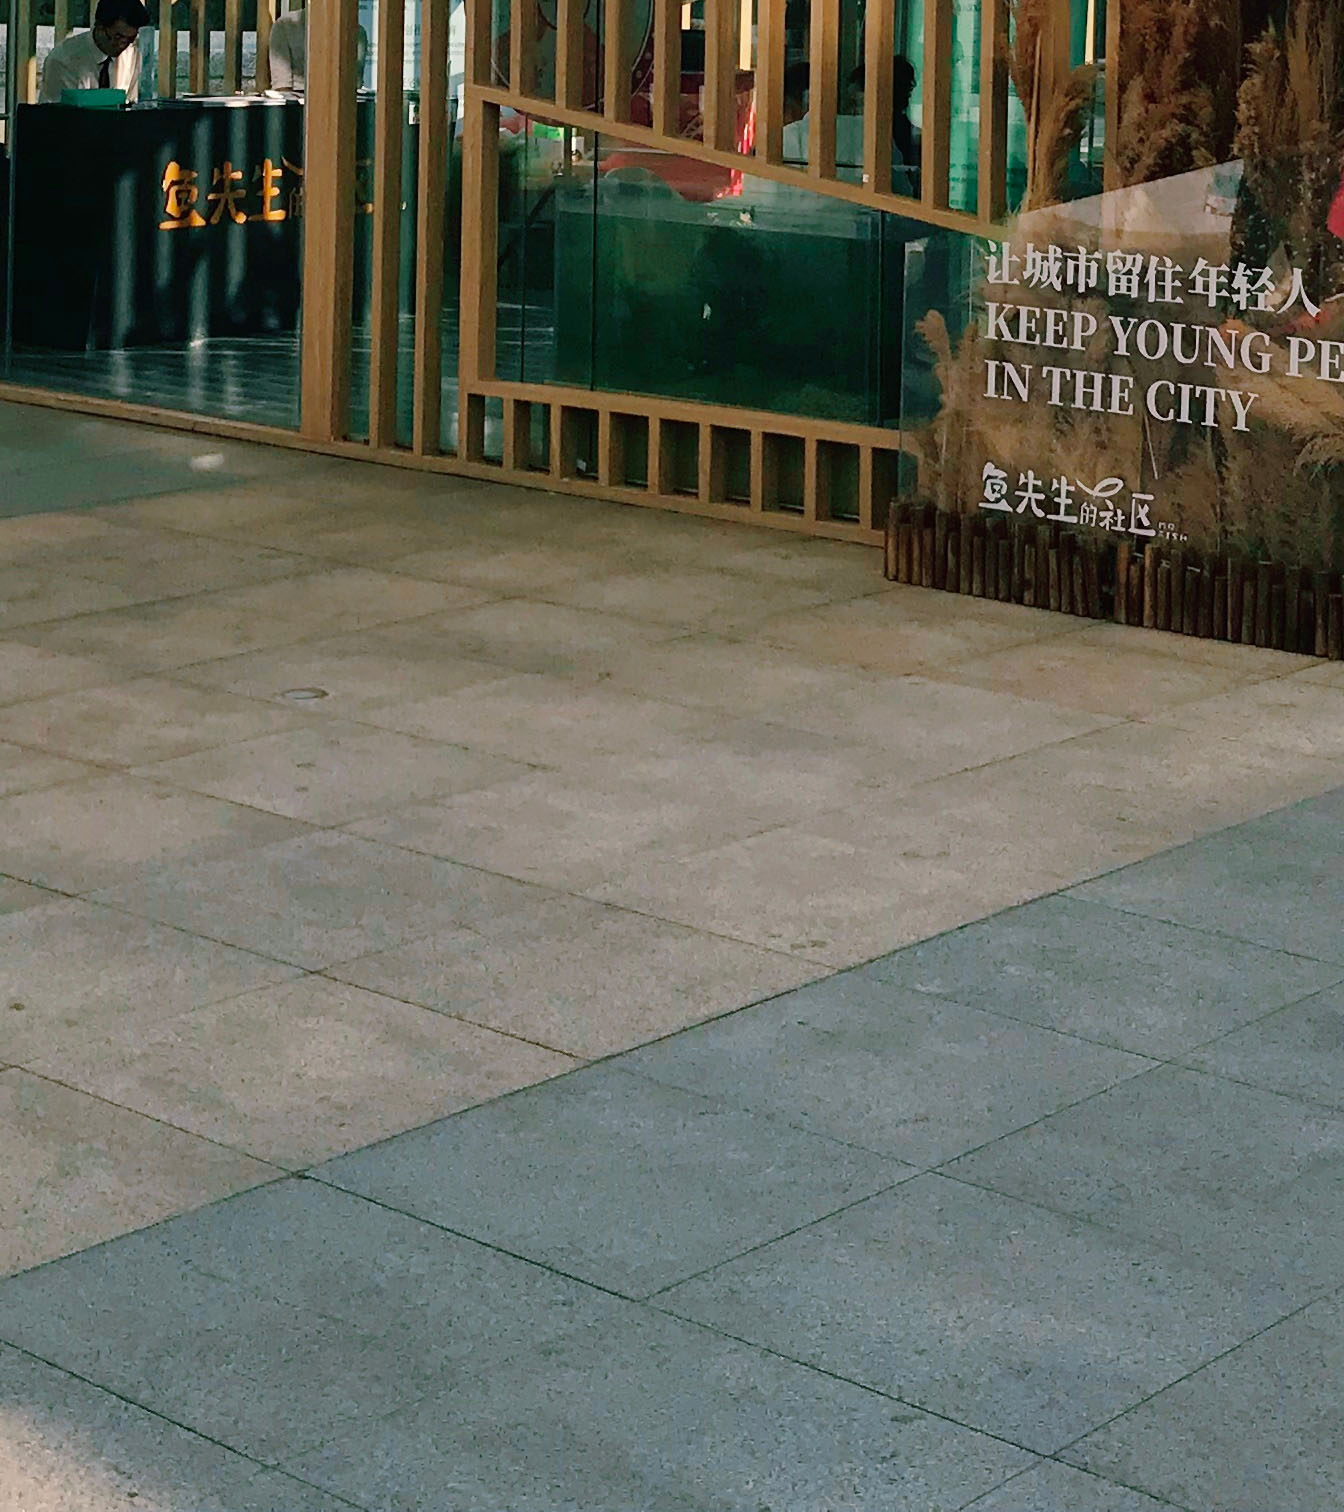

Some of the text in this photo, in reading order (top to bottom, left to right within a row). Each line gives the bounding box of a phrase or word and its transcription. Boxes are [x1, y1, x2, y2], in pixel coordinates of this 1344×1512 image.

[986, 239, 1321, 318] 让城市留住年轻人
[984, 302, 1097, 349] KEEP
[1109, 315, 1272, 374] YOUNG
[984, 360, 1259, 432] IN THE CITY
[978, 462, 1157, 537] 鱼先生的社区
